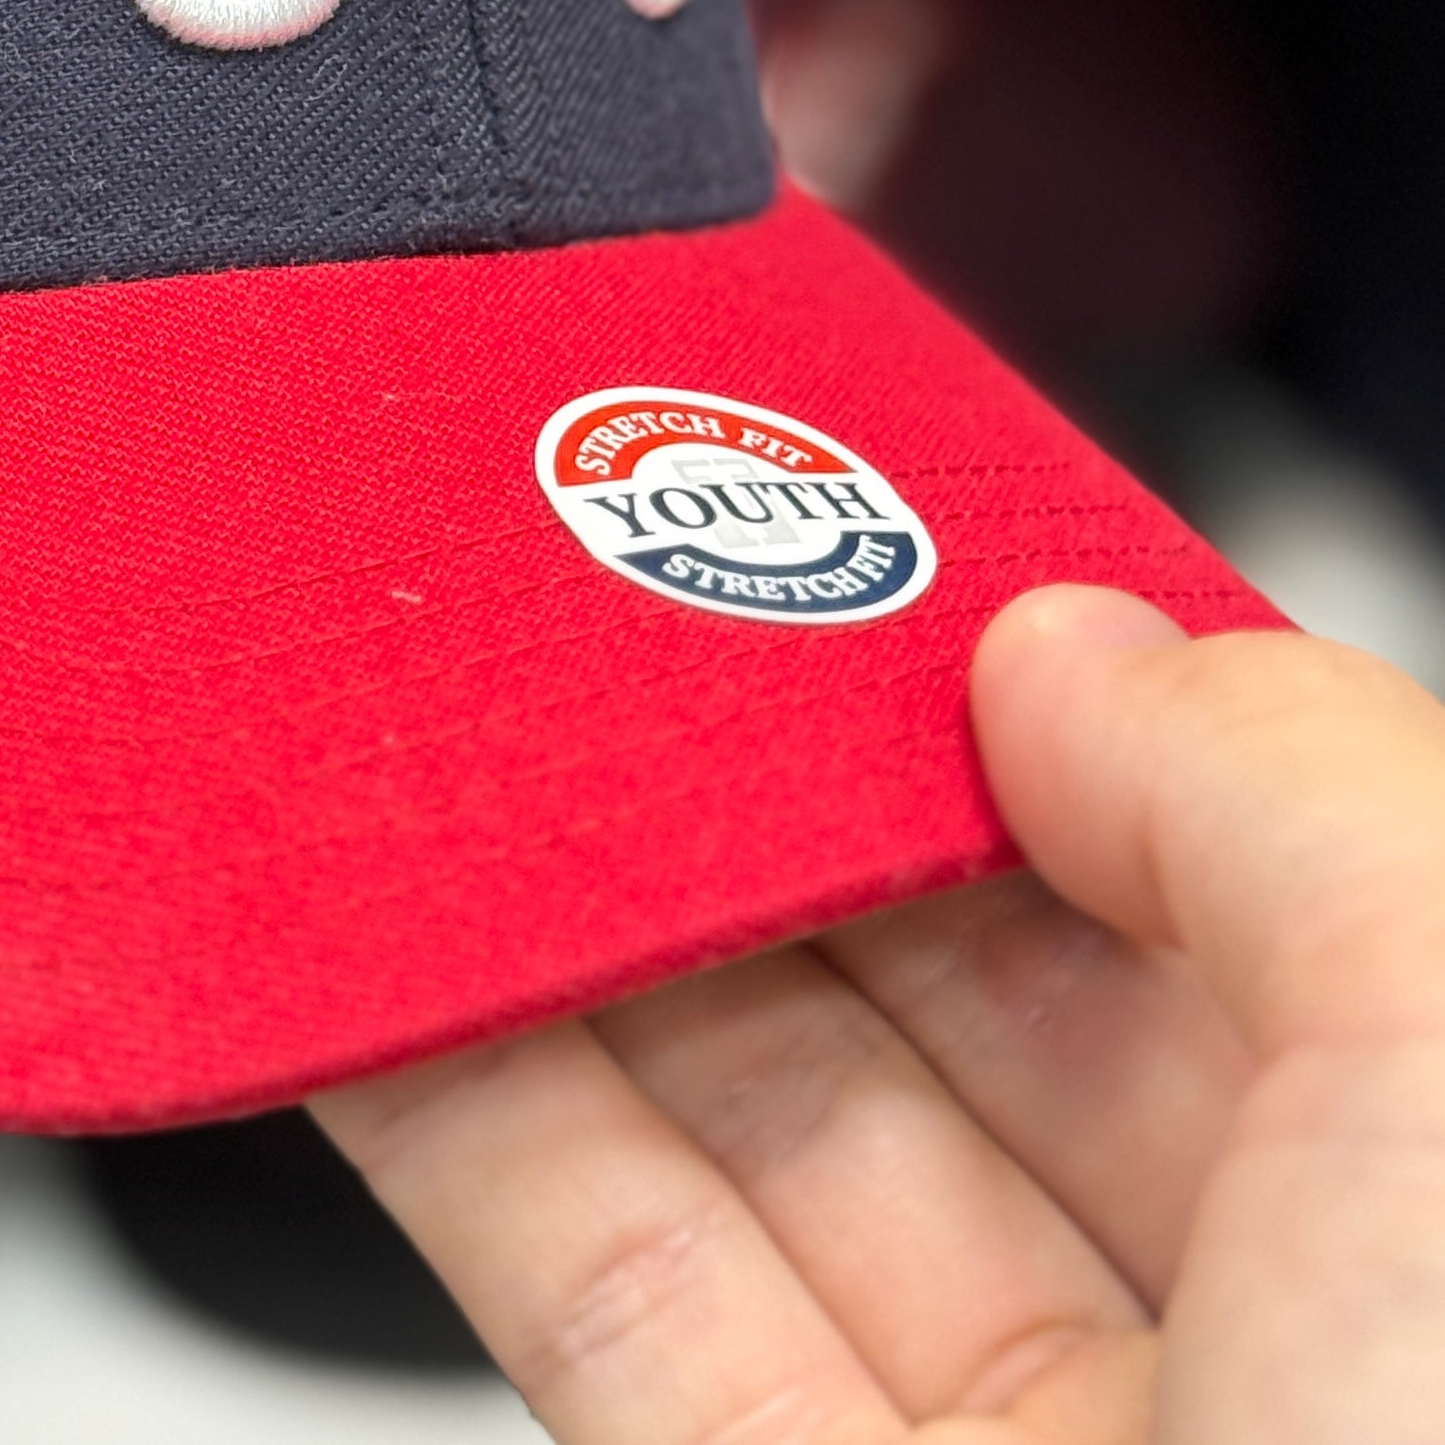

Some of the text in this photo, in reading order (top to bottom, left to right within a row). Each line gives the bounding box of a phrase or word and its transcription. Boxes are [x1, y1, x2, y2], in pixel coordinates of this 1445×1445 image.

[574, 411, 813, 476] STRETCH FIT
[584, 481, 890, 538] YOUTH
